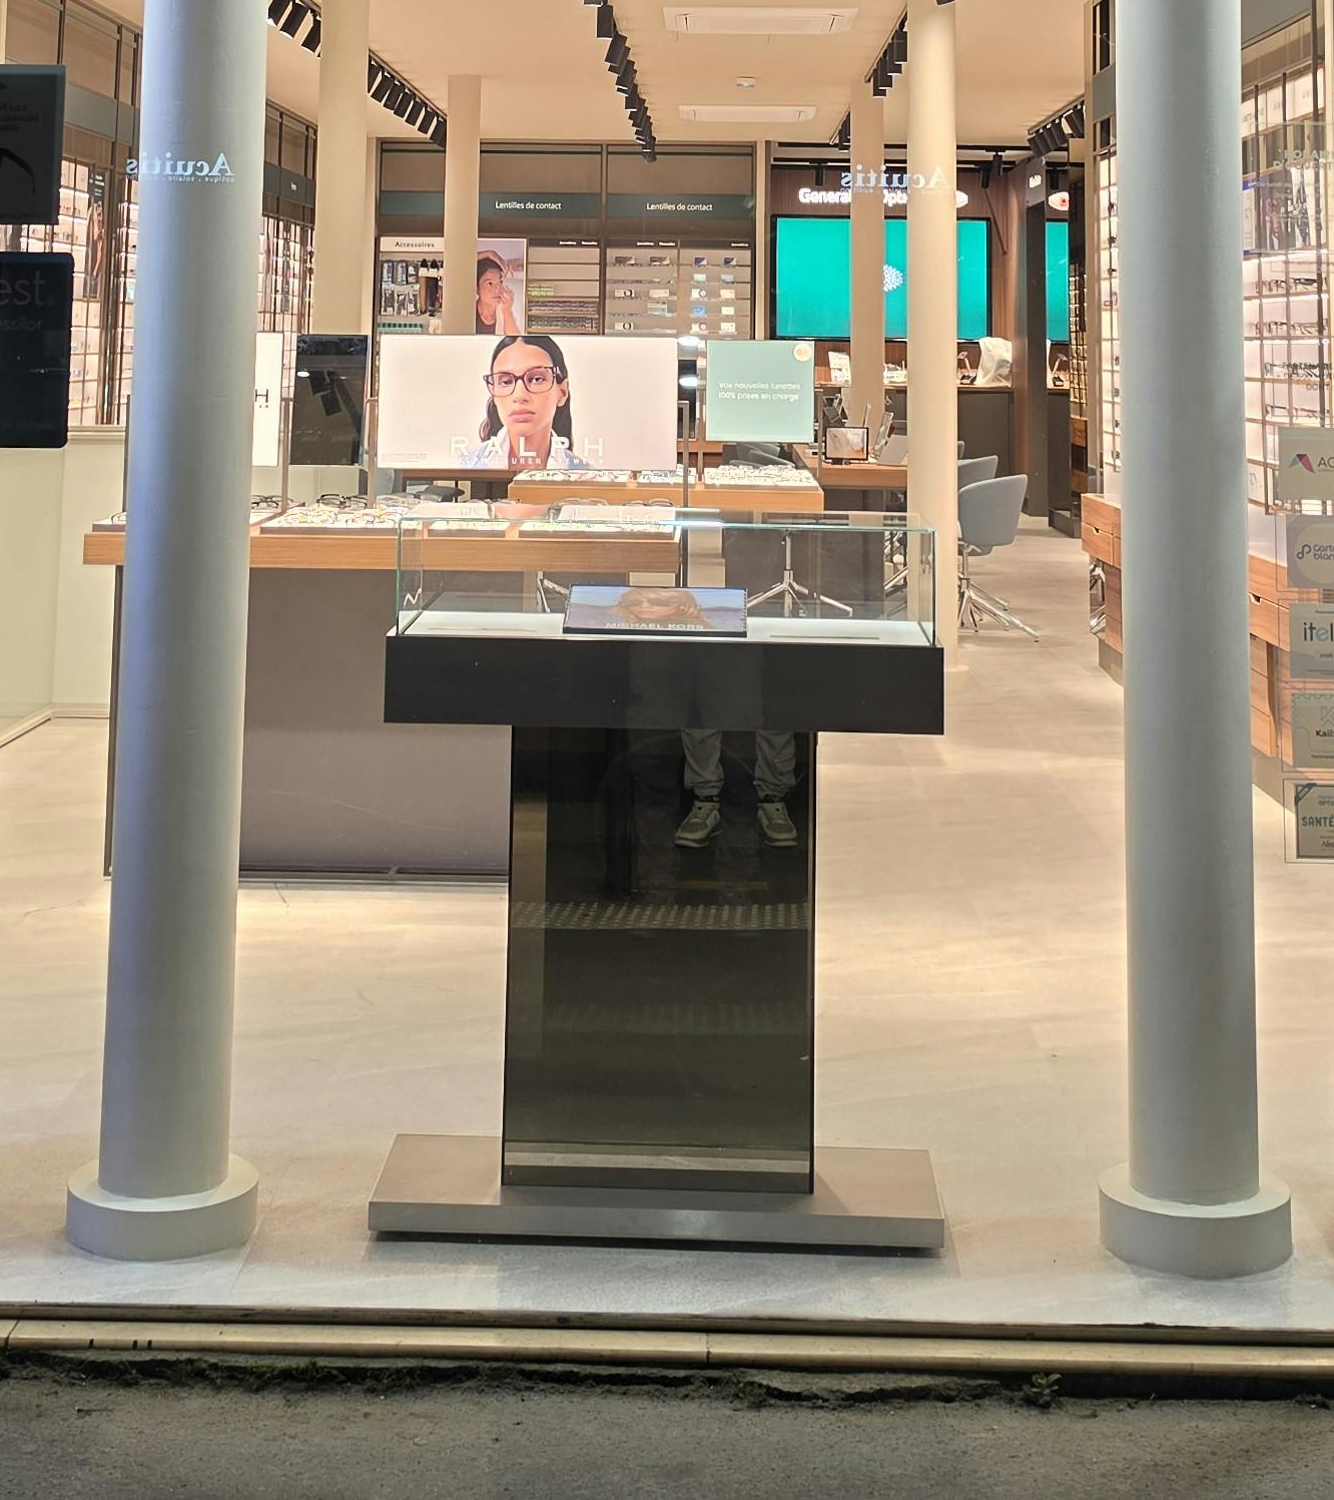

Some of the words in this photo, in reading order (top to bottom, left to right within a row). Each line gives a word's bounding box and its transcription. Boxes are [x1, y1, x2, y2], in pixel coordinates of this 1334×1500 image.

[798, 187, 851, 205] General
[495, 200, 525, 210] Lentilles
[525, 201, 535, 210] de
[536, 201, 562, 211] contact
[646, 202, 675, 211] Lentilles
[676, 203, 686, 211] de
[687, 203, 713, 212] contact
[394, 241, 435, 249] Accessoires
[718, 382, 733, 390] Vos
[734, 381, 769, 390] nouvelles
[770, 382, 801, 391] lunettes
[737, 392, 759, 401] prises
[450, 436, 604, 457] RALPH
[605, 622, 664, 630] MICHAEL
